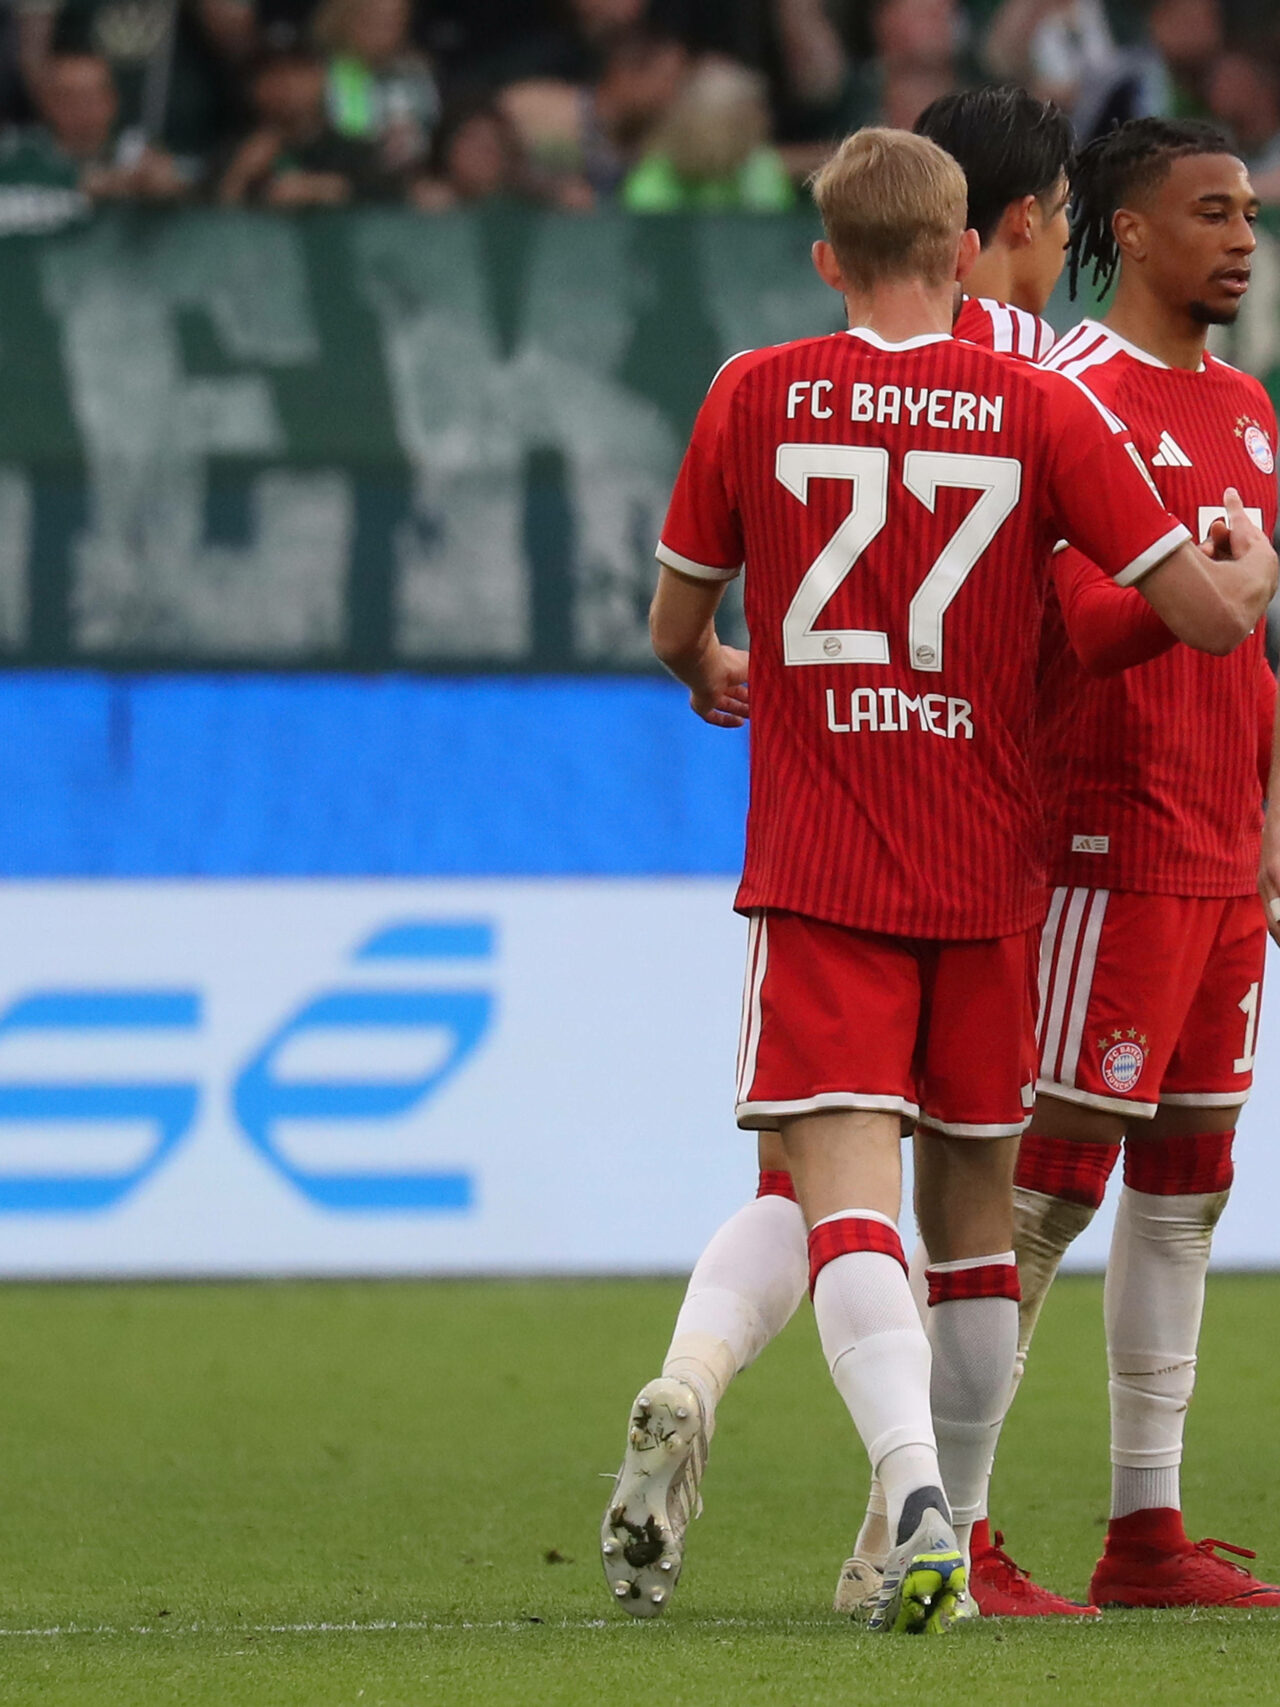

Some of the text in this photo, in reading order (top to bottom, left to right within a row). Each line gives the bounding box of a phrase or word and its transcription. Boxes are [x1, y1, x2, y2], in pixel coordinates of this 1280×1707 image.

[788, 380, 1003, 432] FC BAYERN
[776, 443, 1021, 672] 27
[826, 688, 973, 738] LAIMER
